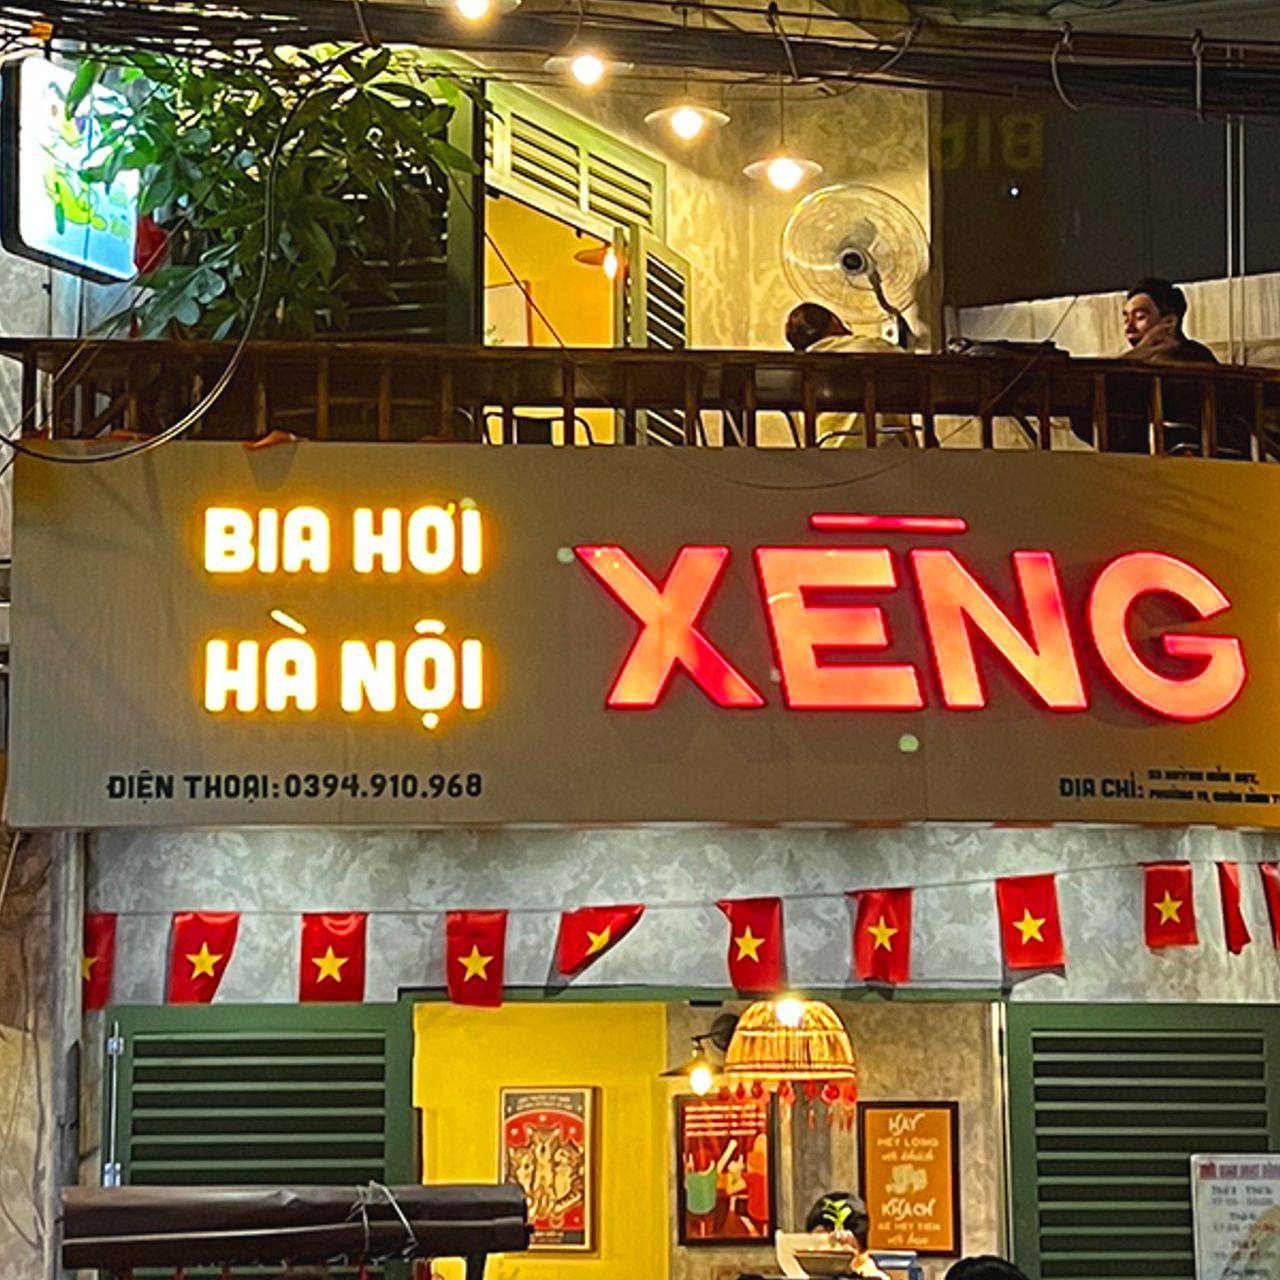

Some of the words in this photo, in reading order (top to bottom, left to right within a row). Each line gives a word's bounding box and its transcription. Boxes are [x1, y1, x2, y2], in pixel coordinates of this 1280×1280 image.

[204, 506, 330, 573] BIA
[353, 500, 484, 573] HƠI
[204, 608, 318, 712] HÀ
[340, 618, 485, 730] NỘI
[106, 770, 174, 804] ĐIỆN
